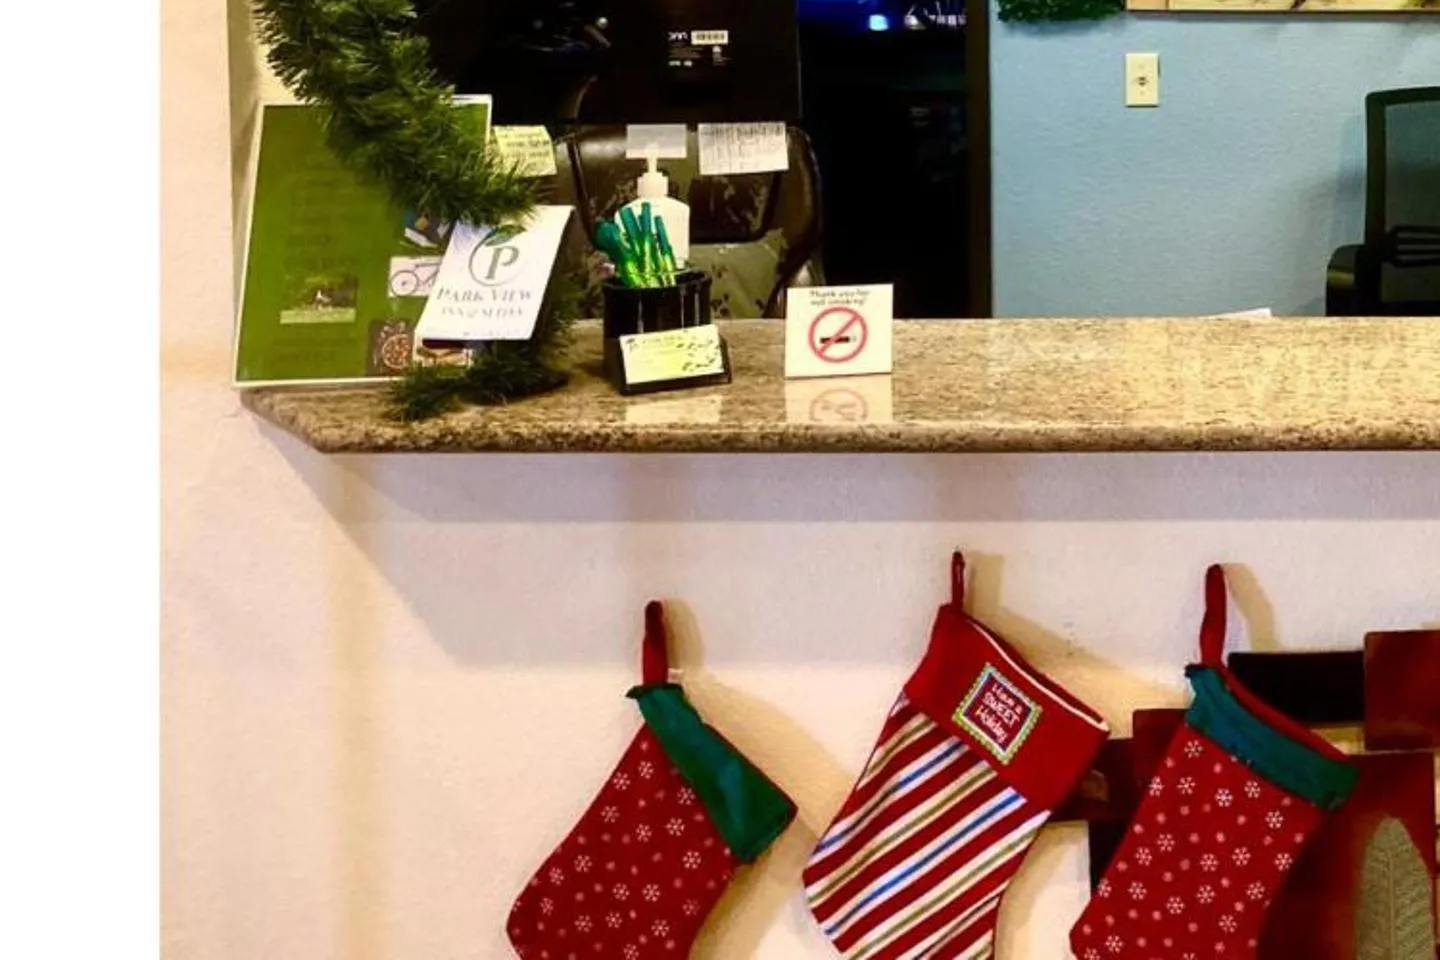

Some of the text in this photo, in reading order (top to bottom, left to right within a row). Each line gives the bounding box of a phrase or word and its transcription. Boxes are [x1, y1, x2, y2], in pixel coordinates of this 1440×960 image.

[484, 245, 520, 280] P
[436, 287, 532, 303] PARK VIEW
[981, 691, 1021, 728] SWEET
